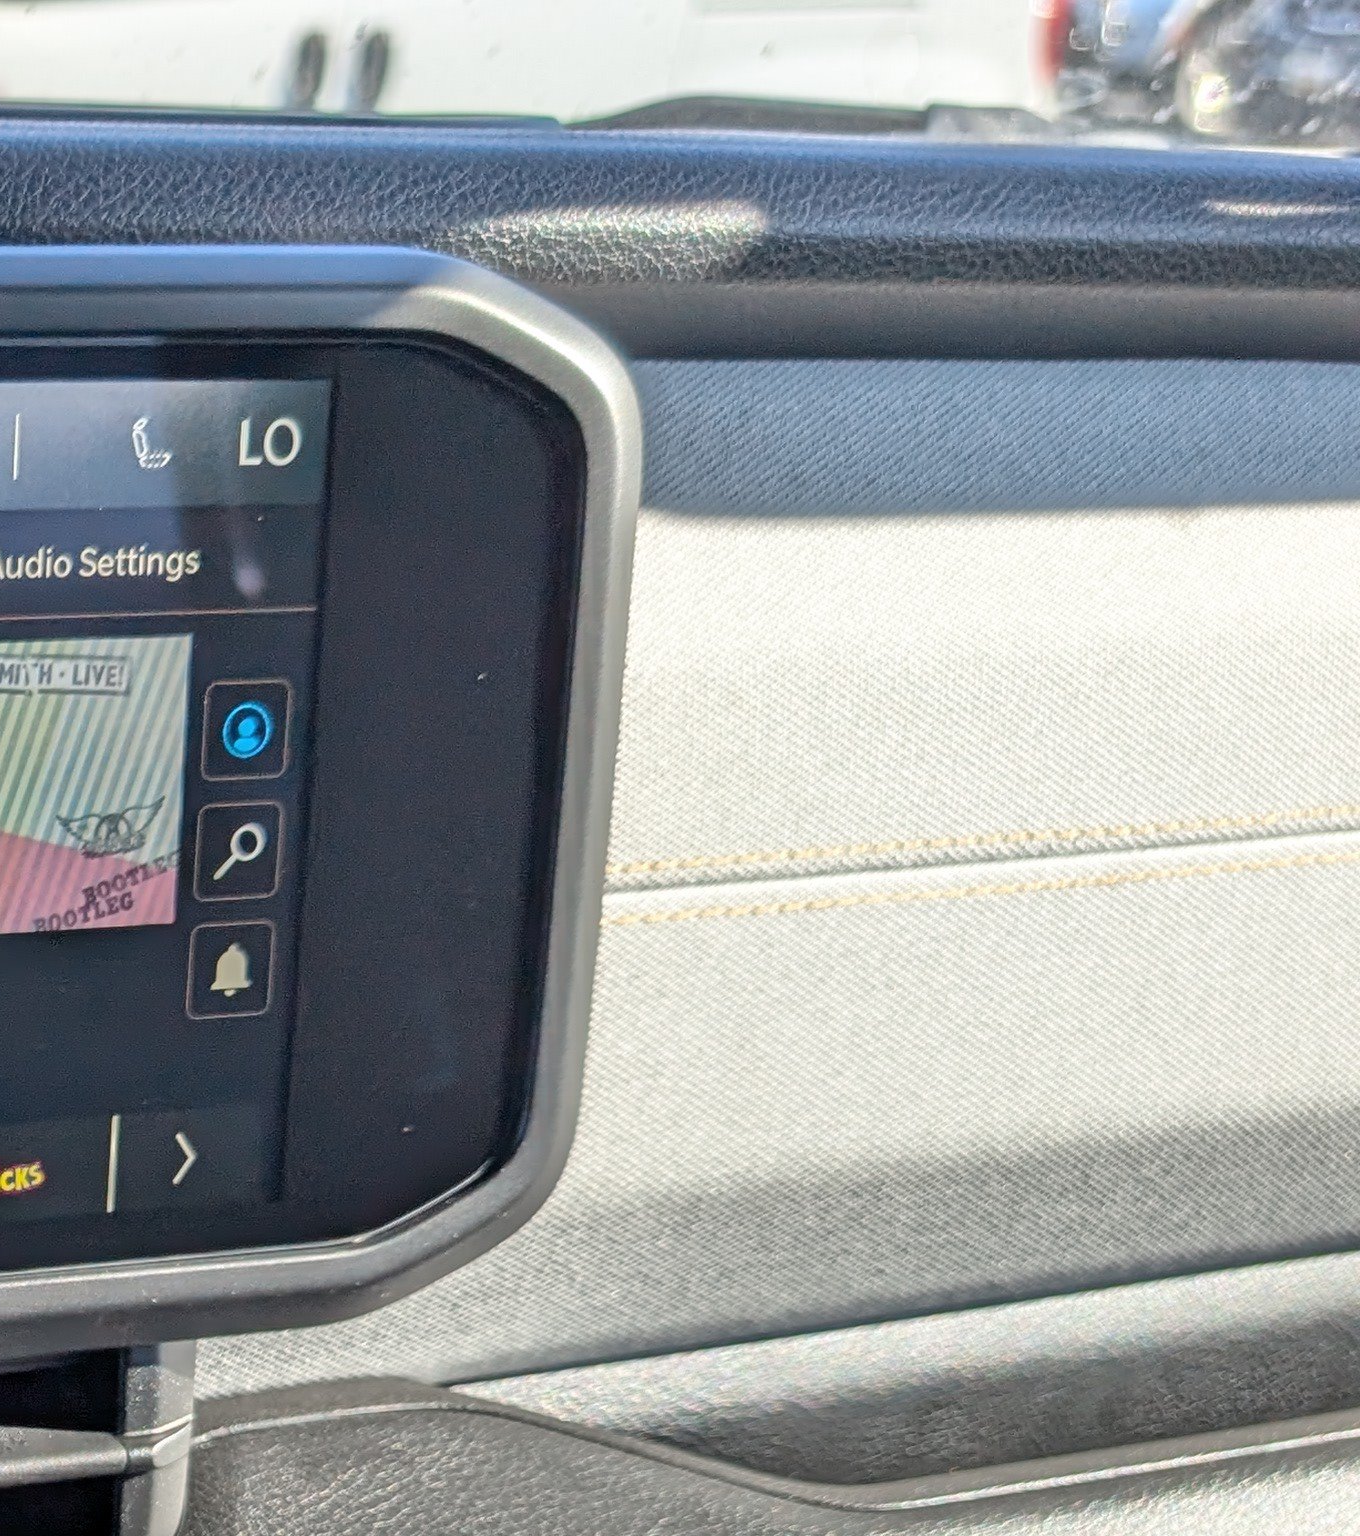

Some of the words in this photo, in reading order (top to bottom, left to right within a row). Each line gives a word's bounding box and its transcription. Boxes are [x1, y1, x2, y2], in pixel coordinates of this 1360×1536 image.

[238, 417, 302, 468] LO
[79, 545, 202, 583] Settings
[71, 664, 124, 687] LIVE!
